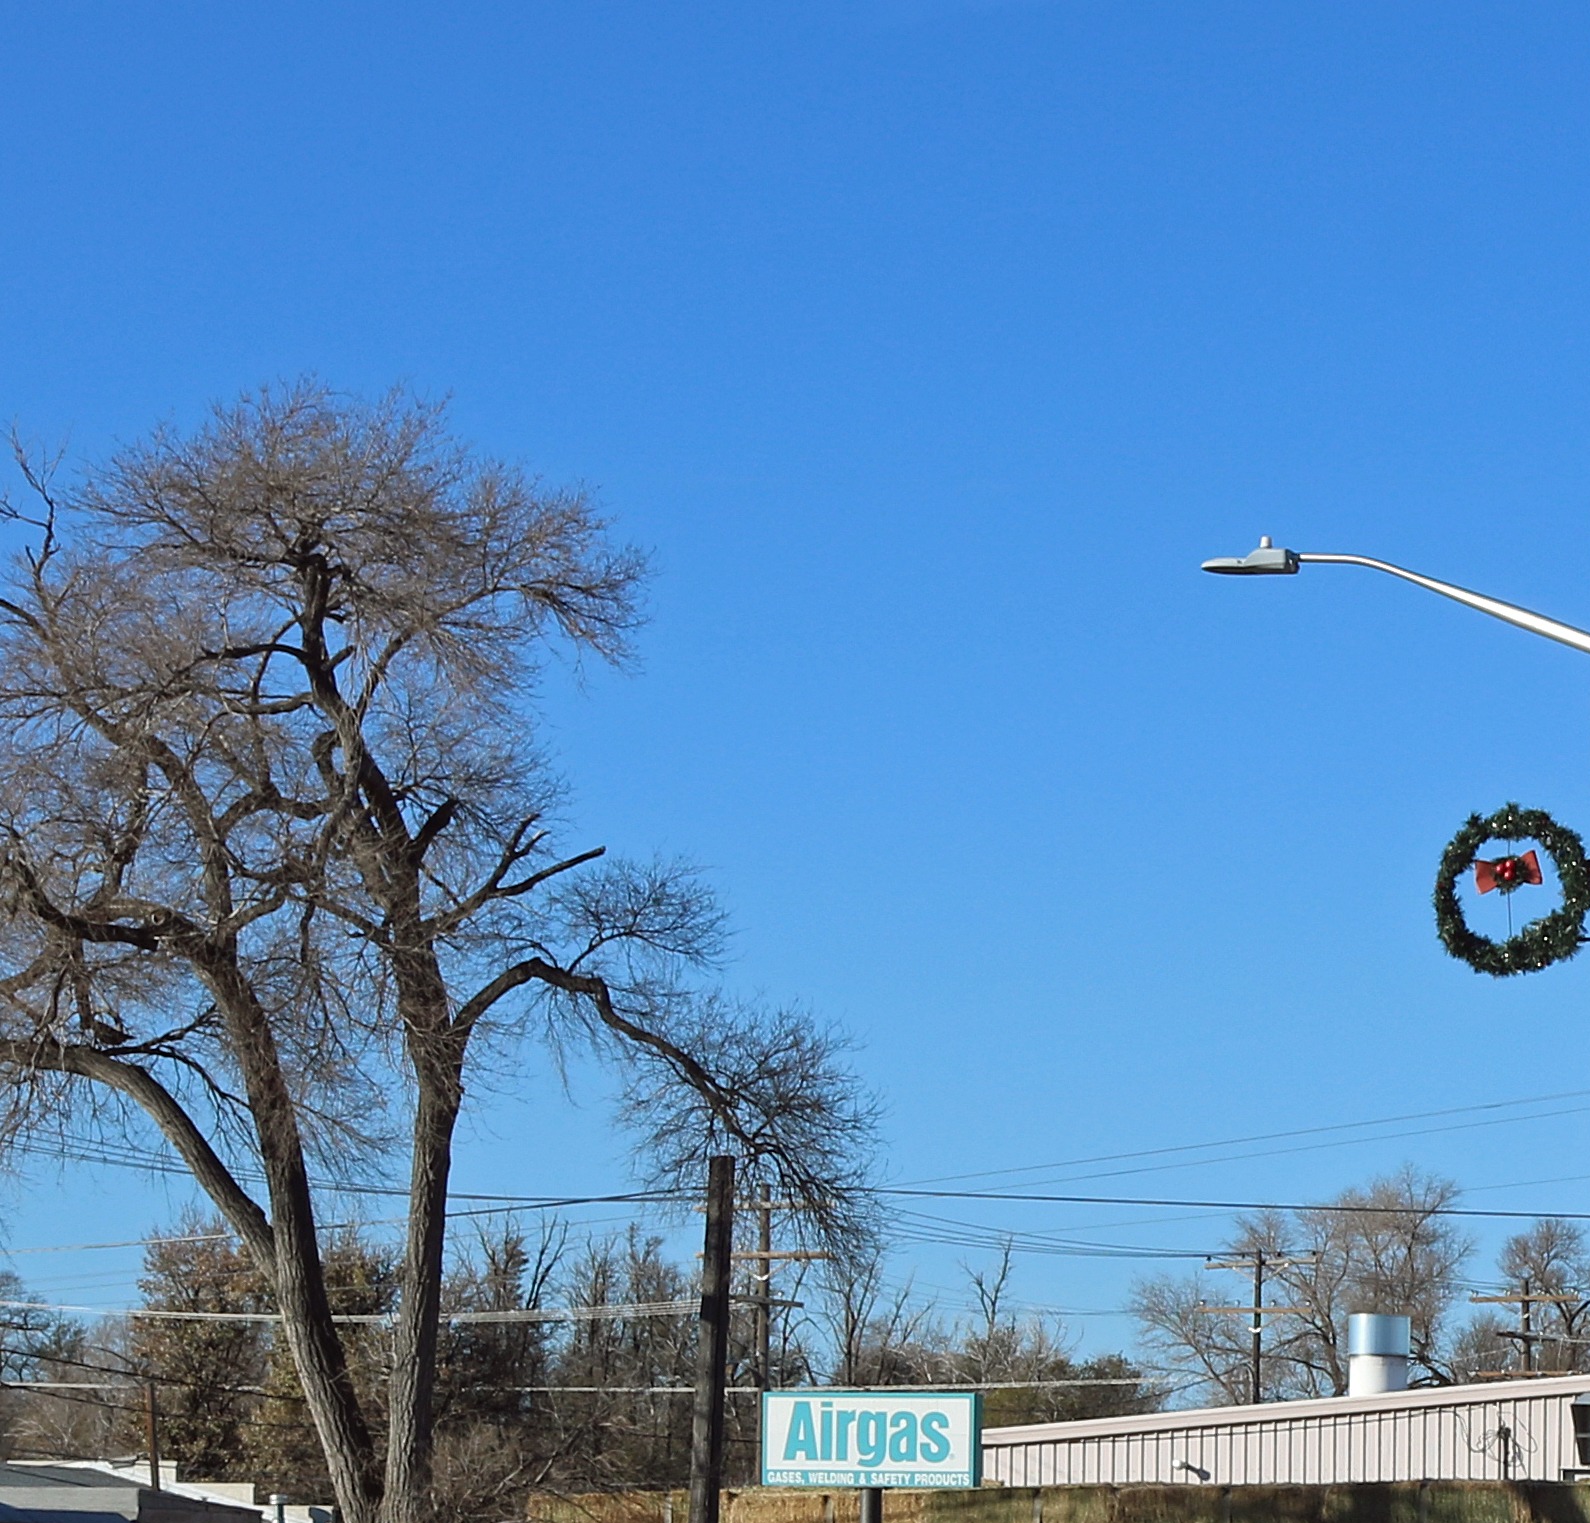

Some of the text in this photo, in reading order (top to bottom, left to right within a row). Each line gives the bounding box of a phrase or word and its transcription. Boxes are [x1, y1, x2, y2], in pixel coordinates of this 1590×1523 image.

[782, 1400, 952, 1467] Airgas
[766, 1471, 970, 1486] GASES, WELDING & SAFETY PRODUCTS
